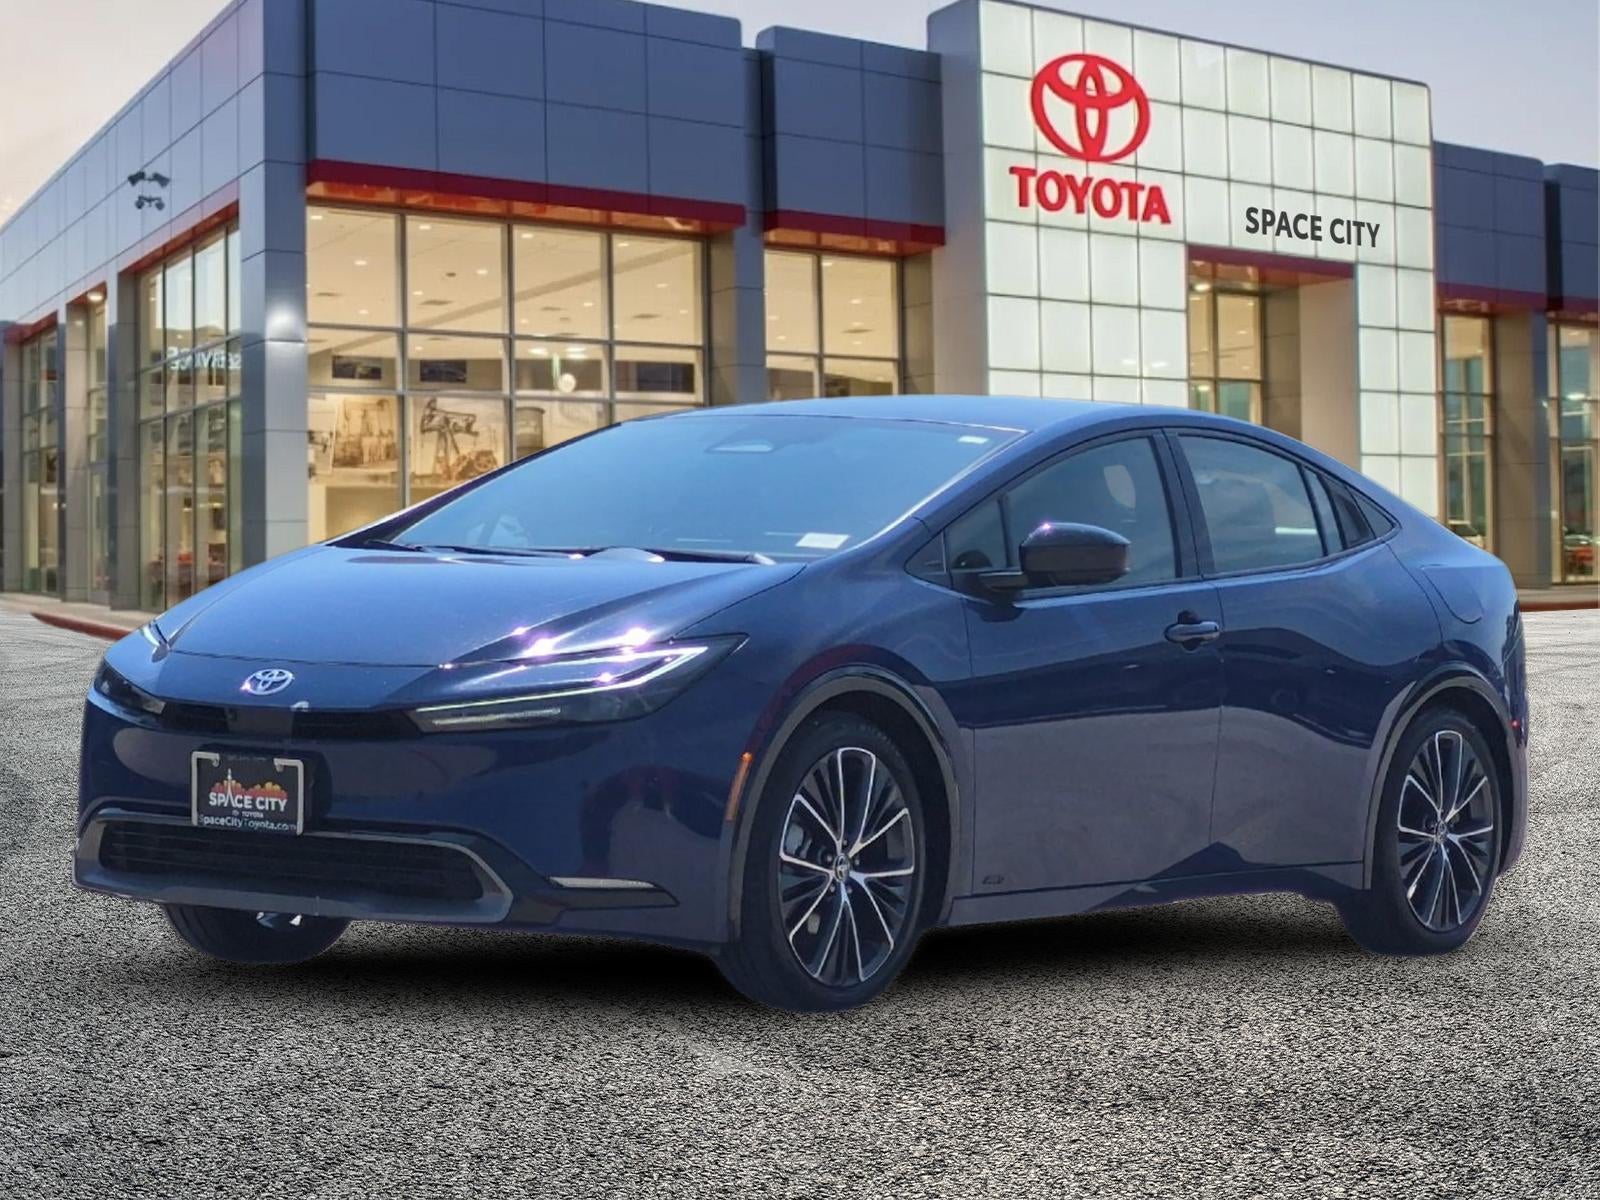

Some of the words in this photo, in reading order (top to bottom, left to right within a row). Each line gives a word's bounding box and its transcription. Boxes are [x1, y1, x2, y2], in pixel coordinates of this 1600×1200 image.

[1009, 166, 1171, 225] TOYOTA
[1245, 206, 1323, 242] SPACE
[1329, 217, 1381, 248] CITY
[209, 792, 252, 808] SPACE
[256, 797, 287, 811] CITY
[199, 815, 297, 830] SpaceCityToyota.com
